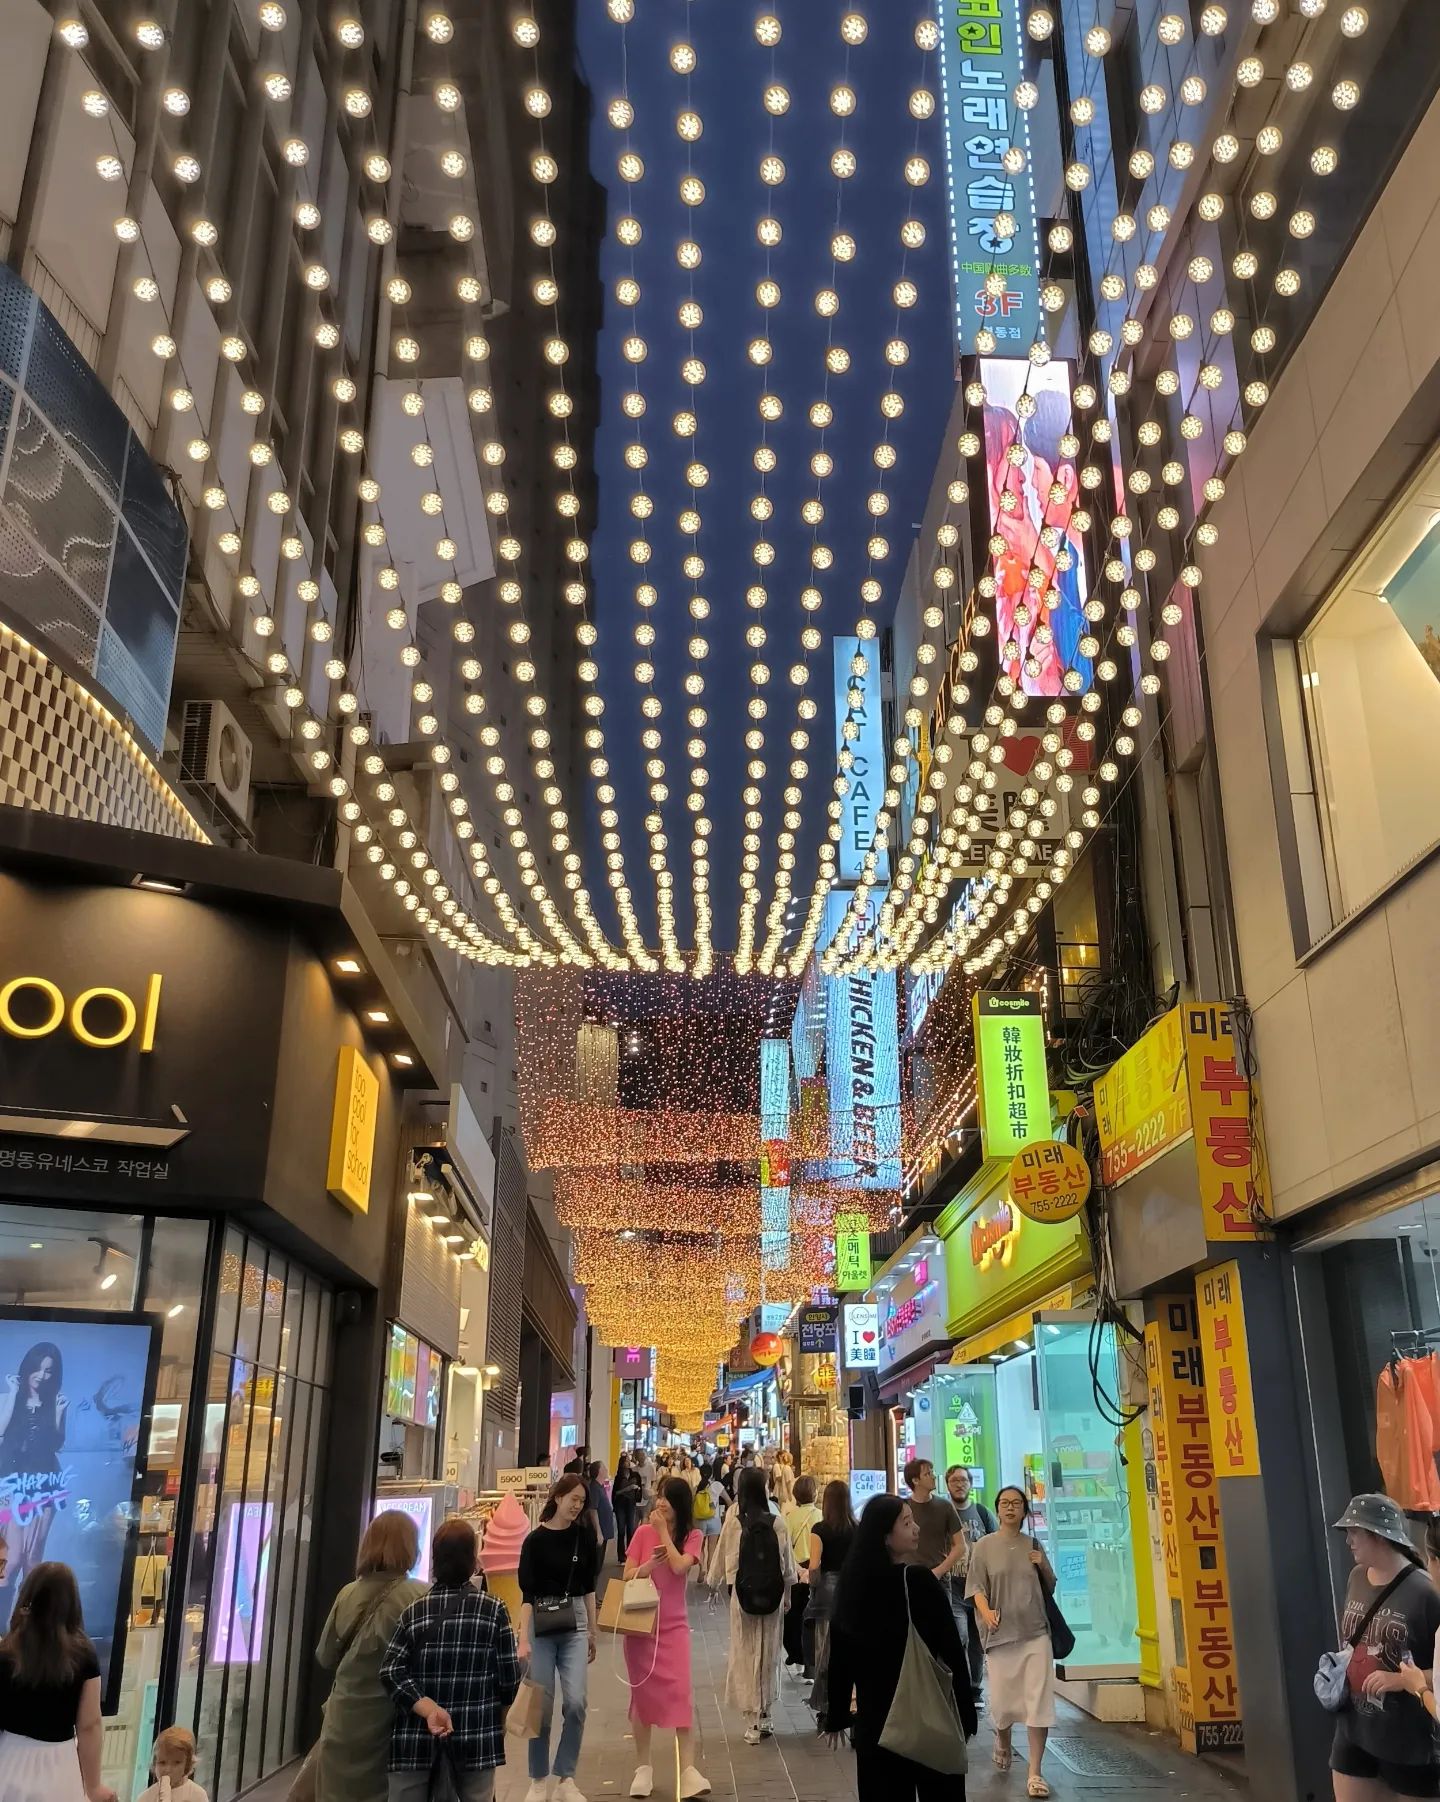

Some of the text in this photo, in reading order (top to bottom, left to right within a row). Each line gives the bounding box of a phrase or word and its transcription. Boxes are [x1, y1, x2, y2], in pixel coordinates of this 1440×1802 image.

[974, 289, 1024, 318] 3F
[849, 756, 871, 851] CAFE
[849, 968, 877, 1080] HICKEN
[355, 1065, 366, 1098] too
[1002, 1026, 1028, 1139] 韓妝折扣超市
[352, 1094, 368, 1125] cool
[350, 1115, 360, 1148] for
[1106, 1097, 1188, 1179] 755-2222 7F
[1200, 1056, 1258, 1233] 부동산
[0, 1150, 170, 1180] 명동유네스코 작업실
[347, 1149, 370, 1187] school
[1021, 1144, 1065, 1169] 미래
[1013, 1164, 1087, 1200] 부동산
[842, 1270, 868, 1281] 아울렛
[1203, 1271, 1232, 1310] 미래
[802, 1323, 836, 1338] 전당포
[1167, 1300, 1205, 1388] 미래
[850, 1348, 876, 1361] 美瞳
[1213, 1313, 1245, 1467] 부동산
[500, 1475, 523, 1484] 5900
[528, 1471, 548, 1480] 5900
[860, 1473, 873, 1482] Cat
[1176, 1392, 1220, 1541] 부동산
[855, 1481, 874, 1491] Cafe
[1194, 1579, 1238, 1719] 부동산
[1198, 1724, 1243, 1746] 755-222
